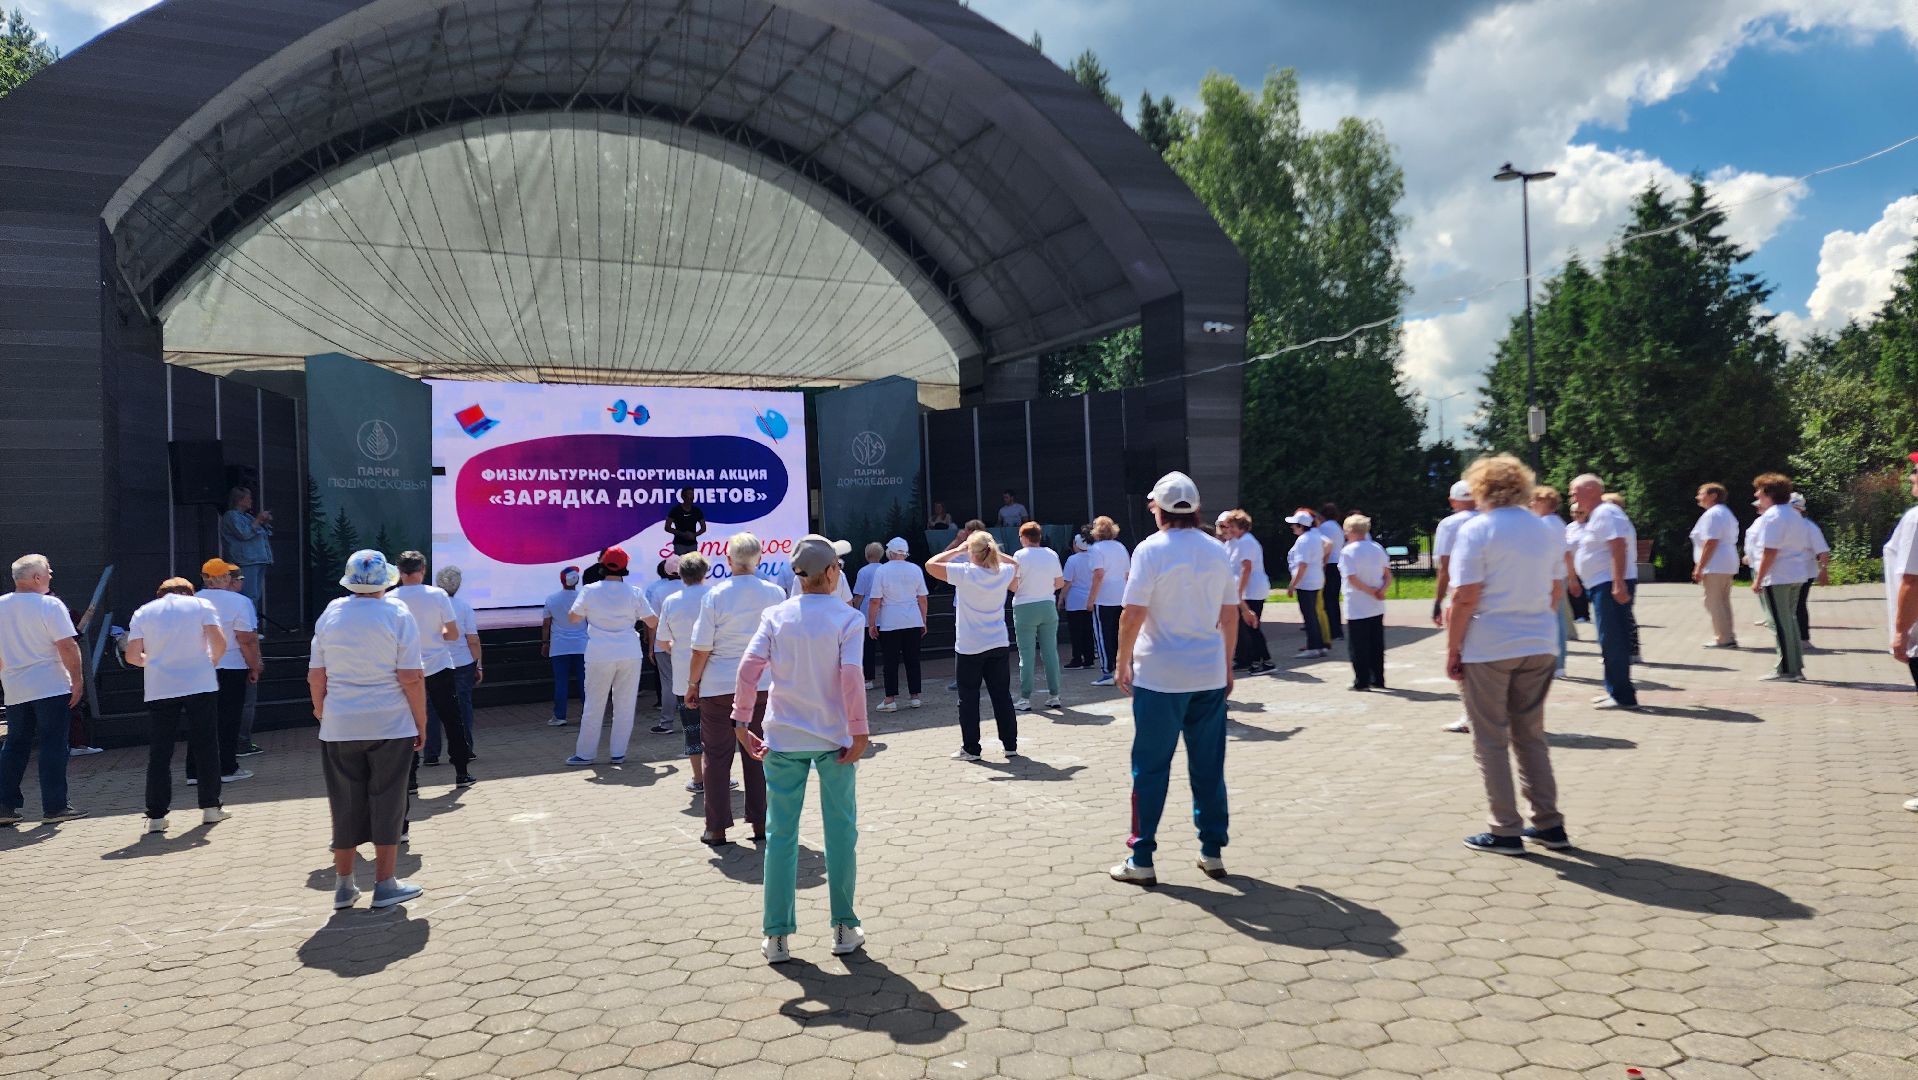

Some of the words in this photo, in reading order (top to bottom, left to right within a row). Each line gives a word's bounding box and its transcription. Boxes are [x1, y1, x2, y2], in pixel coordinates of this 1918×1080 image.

[357, 466, 400, 477] ПАРКИ
[481, 468, 715, 481] ФИЗКУЛЬТУРНО-СПОРТИВНАЯ
[719, 468, 768, 482] АКЦИЯ
[854, 468, 885, 477] ПАРКИ
[327, 477, 427, 490] ПОДМОСКОВЬЯ
[836, 476, 903, 488] ДОМОДЕДОВО
[489, 488, 611, 509] «ЗАРЯДКА
